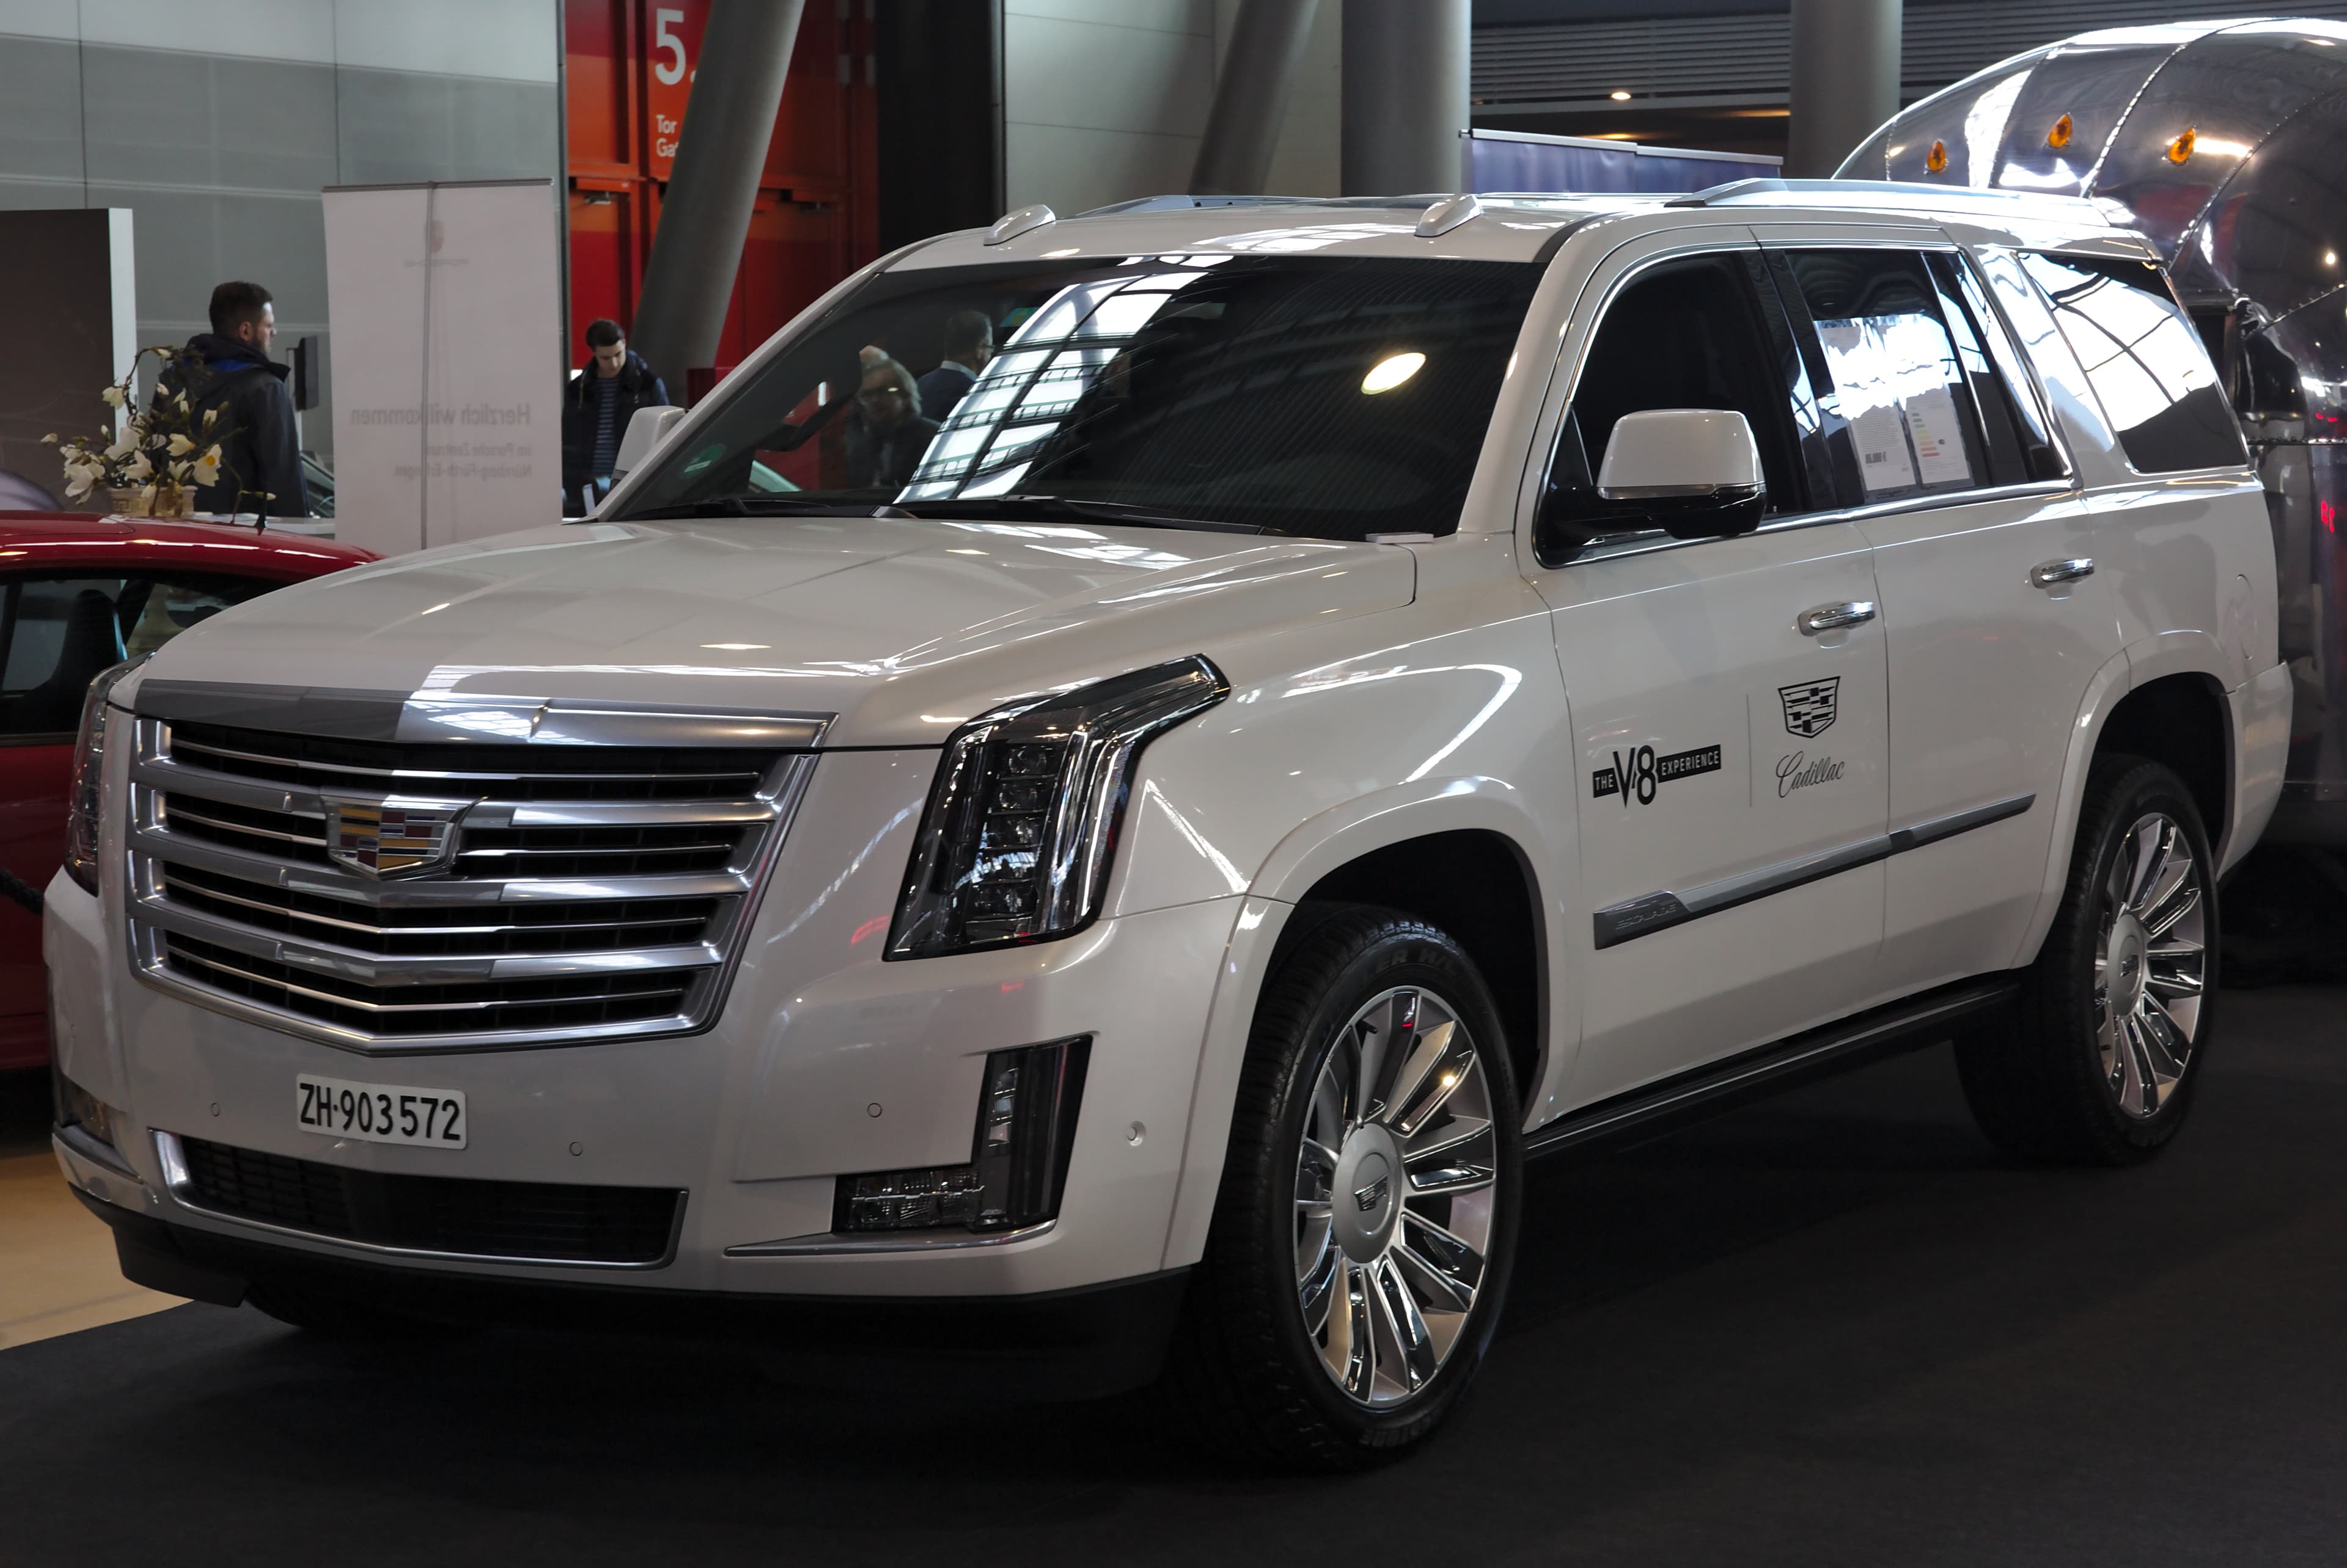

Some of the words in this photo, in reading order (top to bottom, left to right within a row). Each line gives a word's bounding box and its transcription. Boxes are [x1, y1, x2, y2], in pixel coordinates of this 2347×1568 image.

[656, 114, 677, 134] Tor
[1595, 774, 1614, 791] THE
[1612, 745, 1656, 809] V8
[1661, 750, 1720, 776] EXPERIENCE
[1776, 750, 1845, 798] Cadillac
